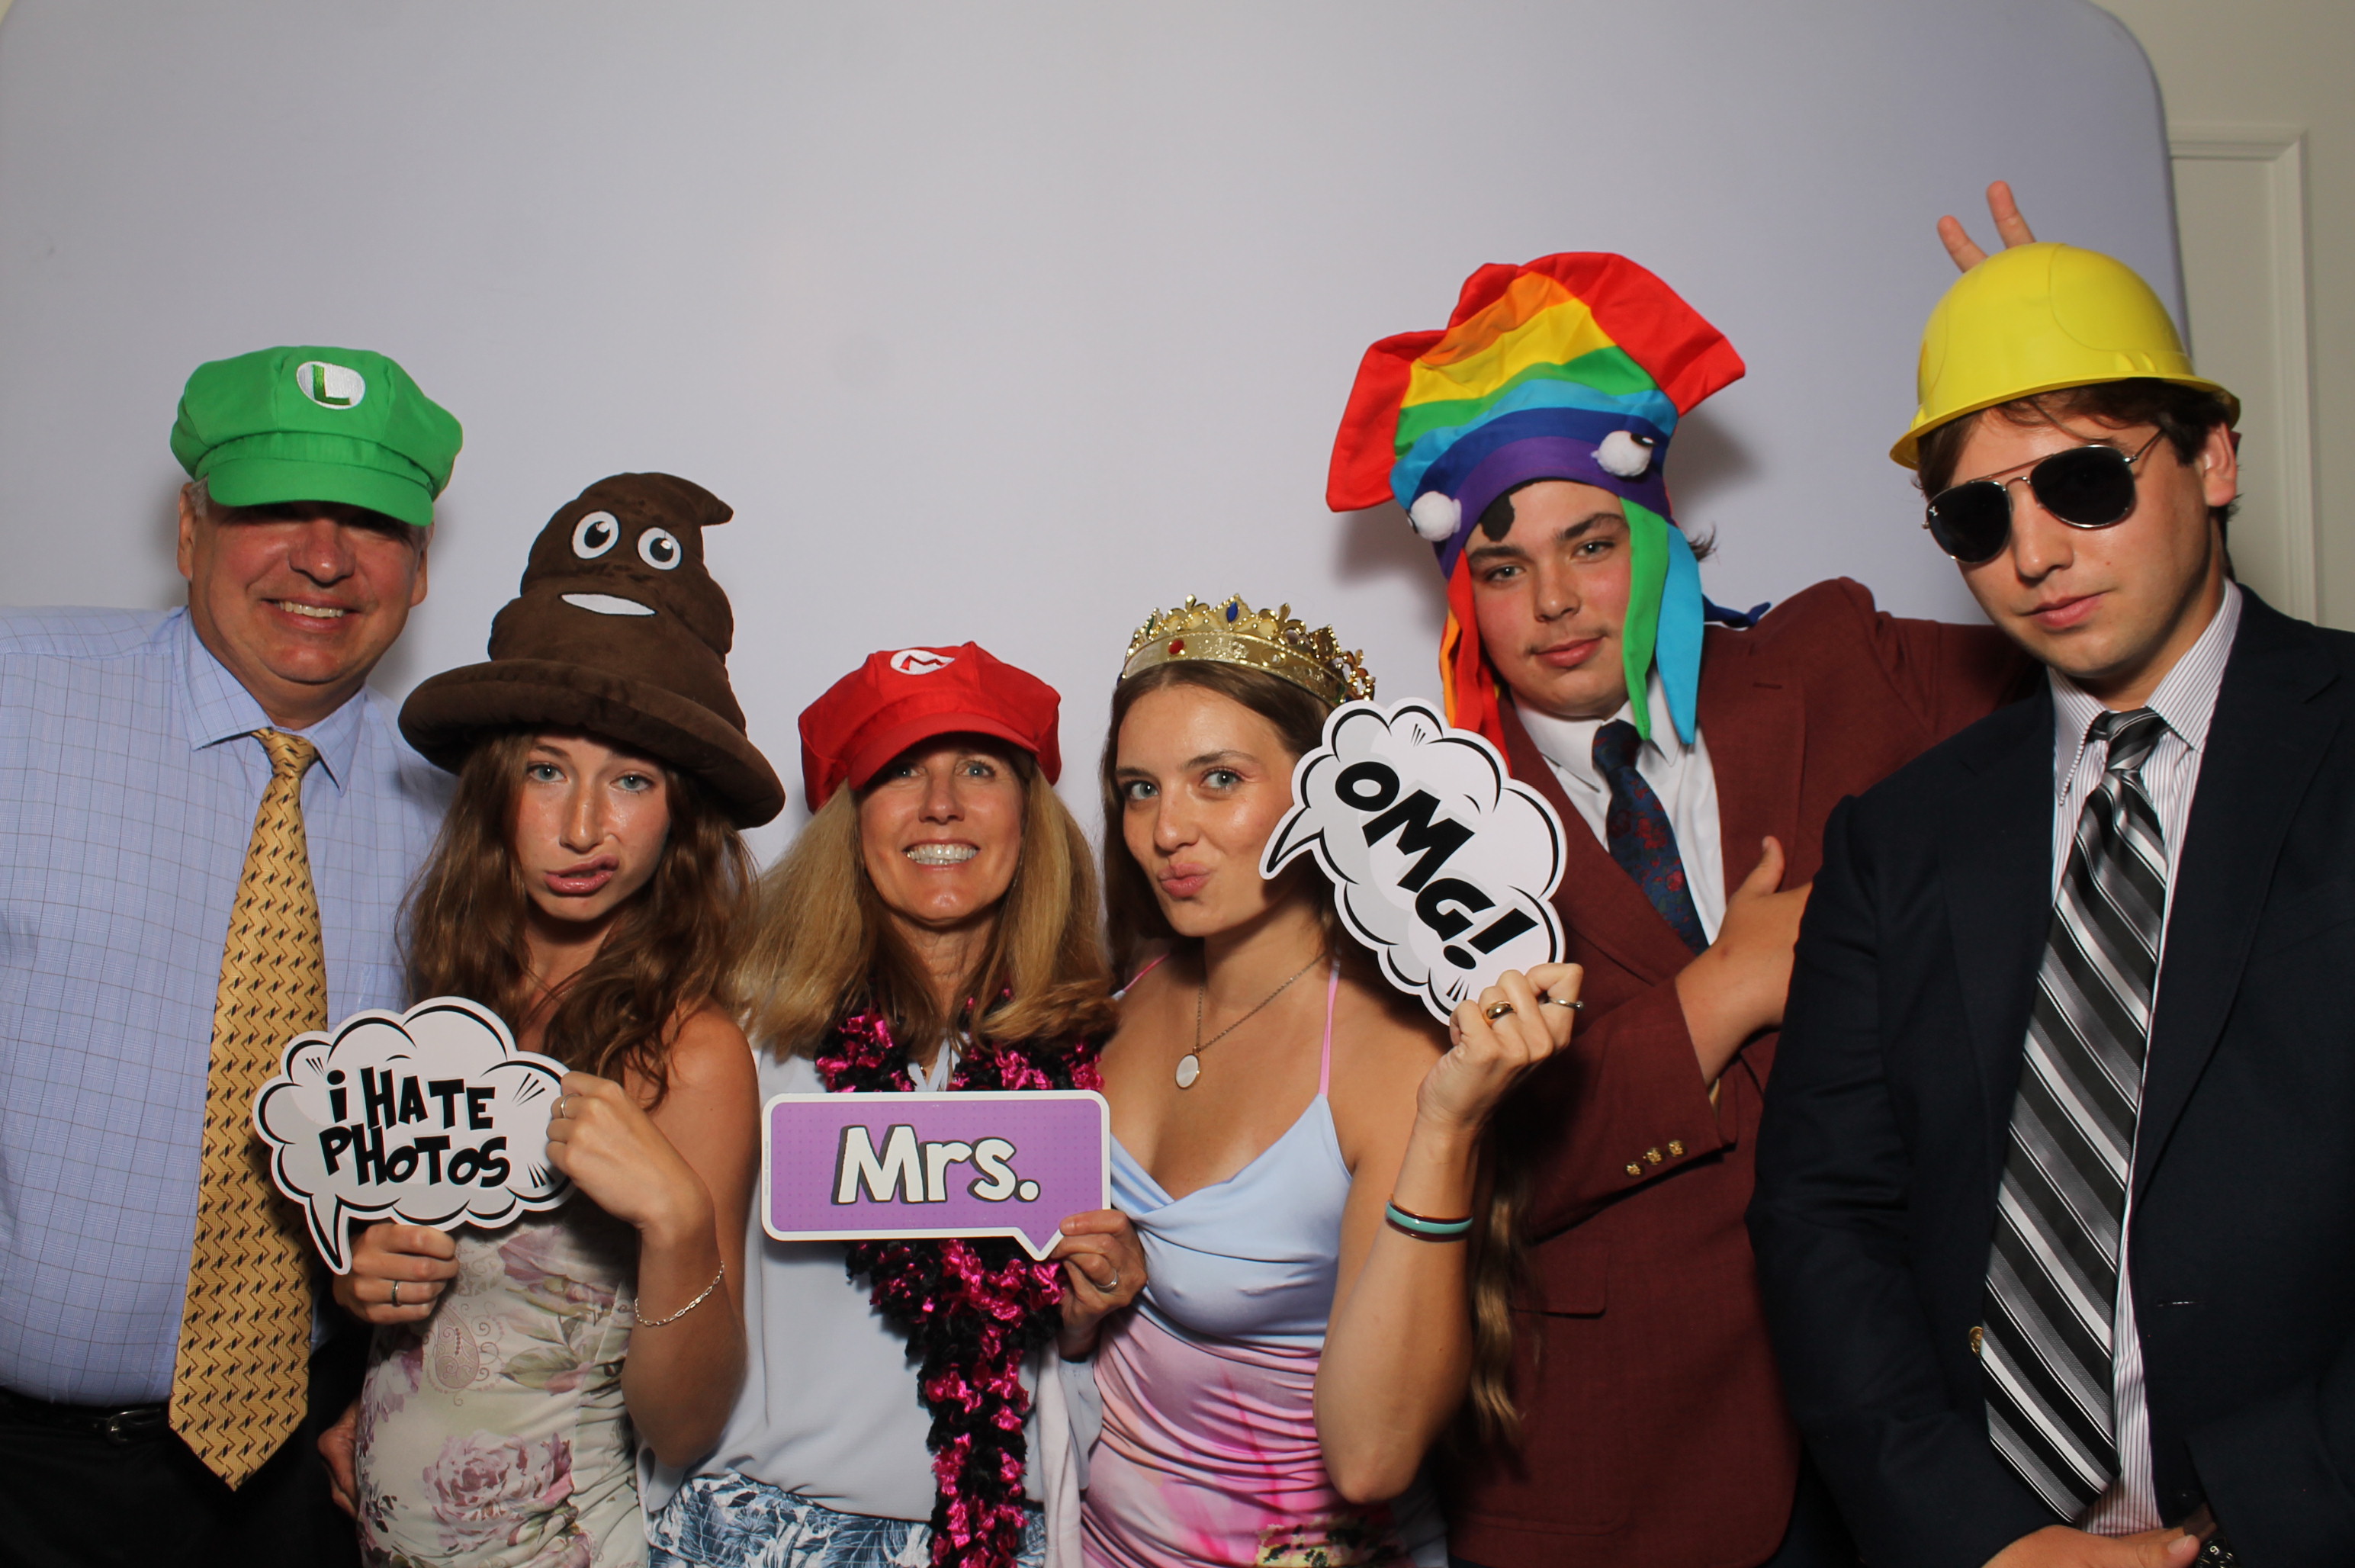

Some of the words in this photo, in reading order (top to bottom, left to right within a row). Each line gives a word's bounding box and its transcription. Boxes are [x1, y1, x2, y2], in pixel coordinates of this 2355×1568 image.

[312, 364, 352, 406] L
[1335, 761, 1539, 970] OMG!
[360, 1066, 496, 1131] HATE
[318, 1123, 511, 1188] PHOTOS
[831, 1123, 1041, 1206] Mrs.
